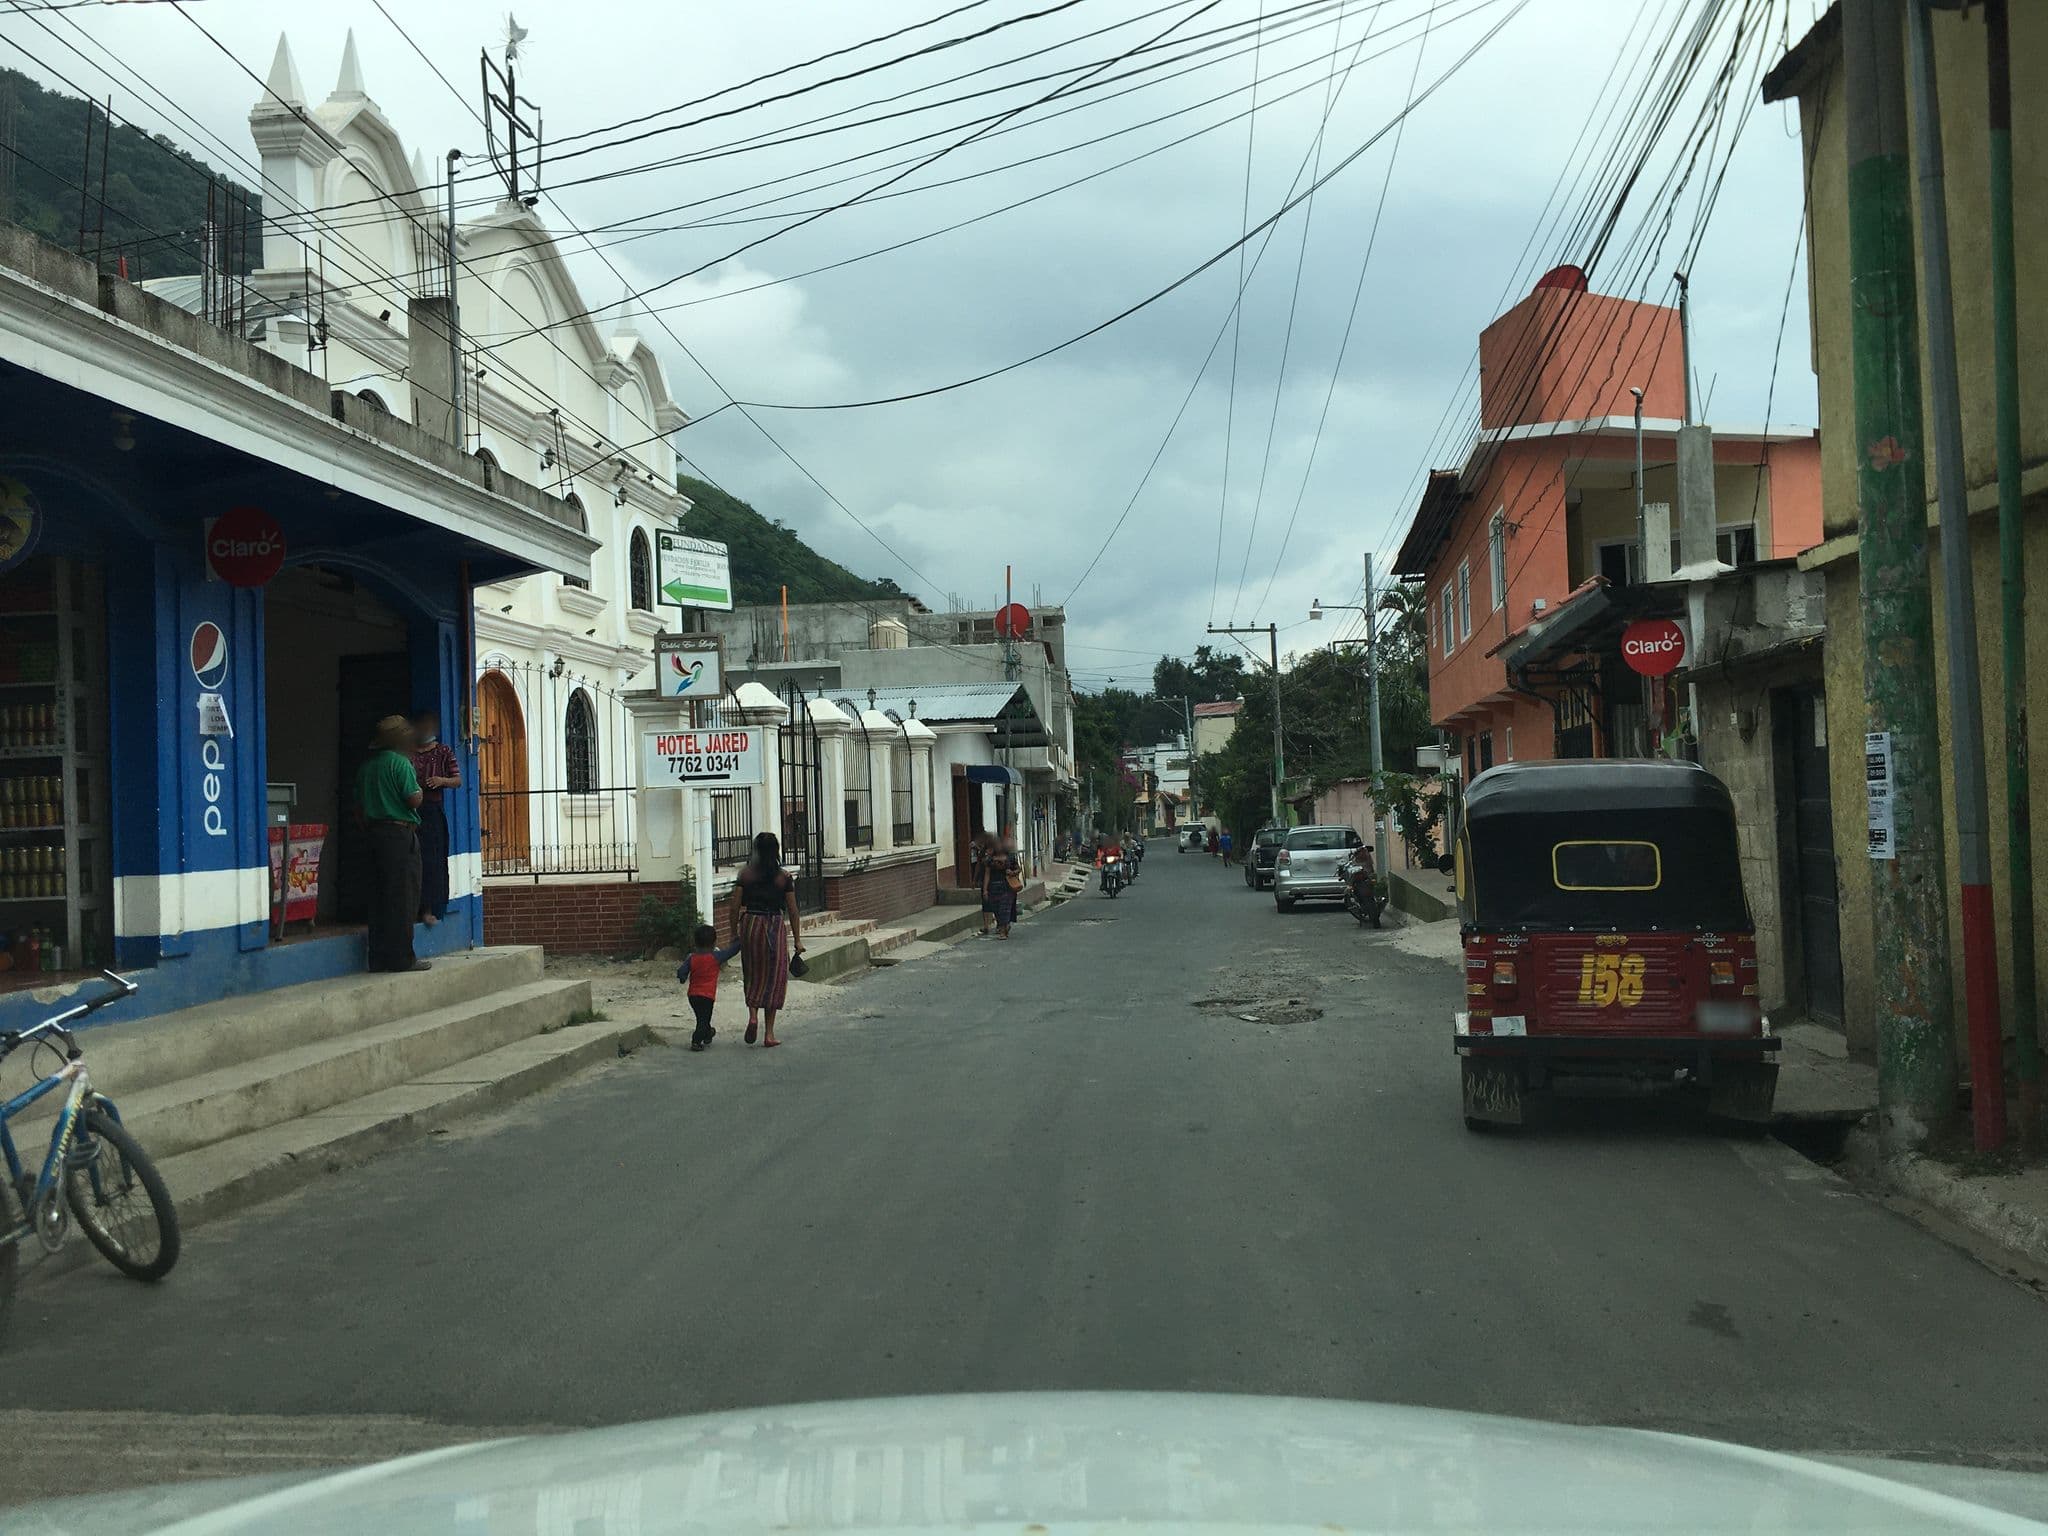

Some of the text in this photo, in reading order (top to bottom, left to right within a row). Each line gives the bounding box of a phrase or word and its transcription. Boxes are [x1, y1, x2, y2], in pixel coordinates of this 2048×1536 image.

[212, 535, 275, 558] Claro
[1625, 635, 1678, 655] Claro
[657, 732, 749, 756] HOTEL JARED
[668, 754, 740, 773] 7762 0341
[202, 739, 228, 837] pep
[1577, 953, 1647, 1008] 158
